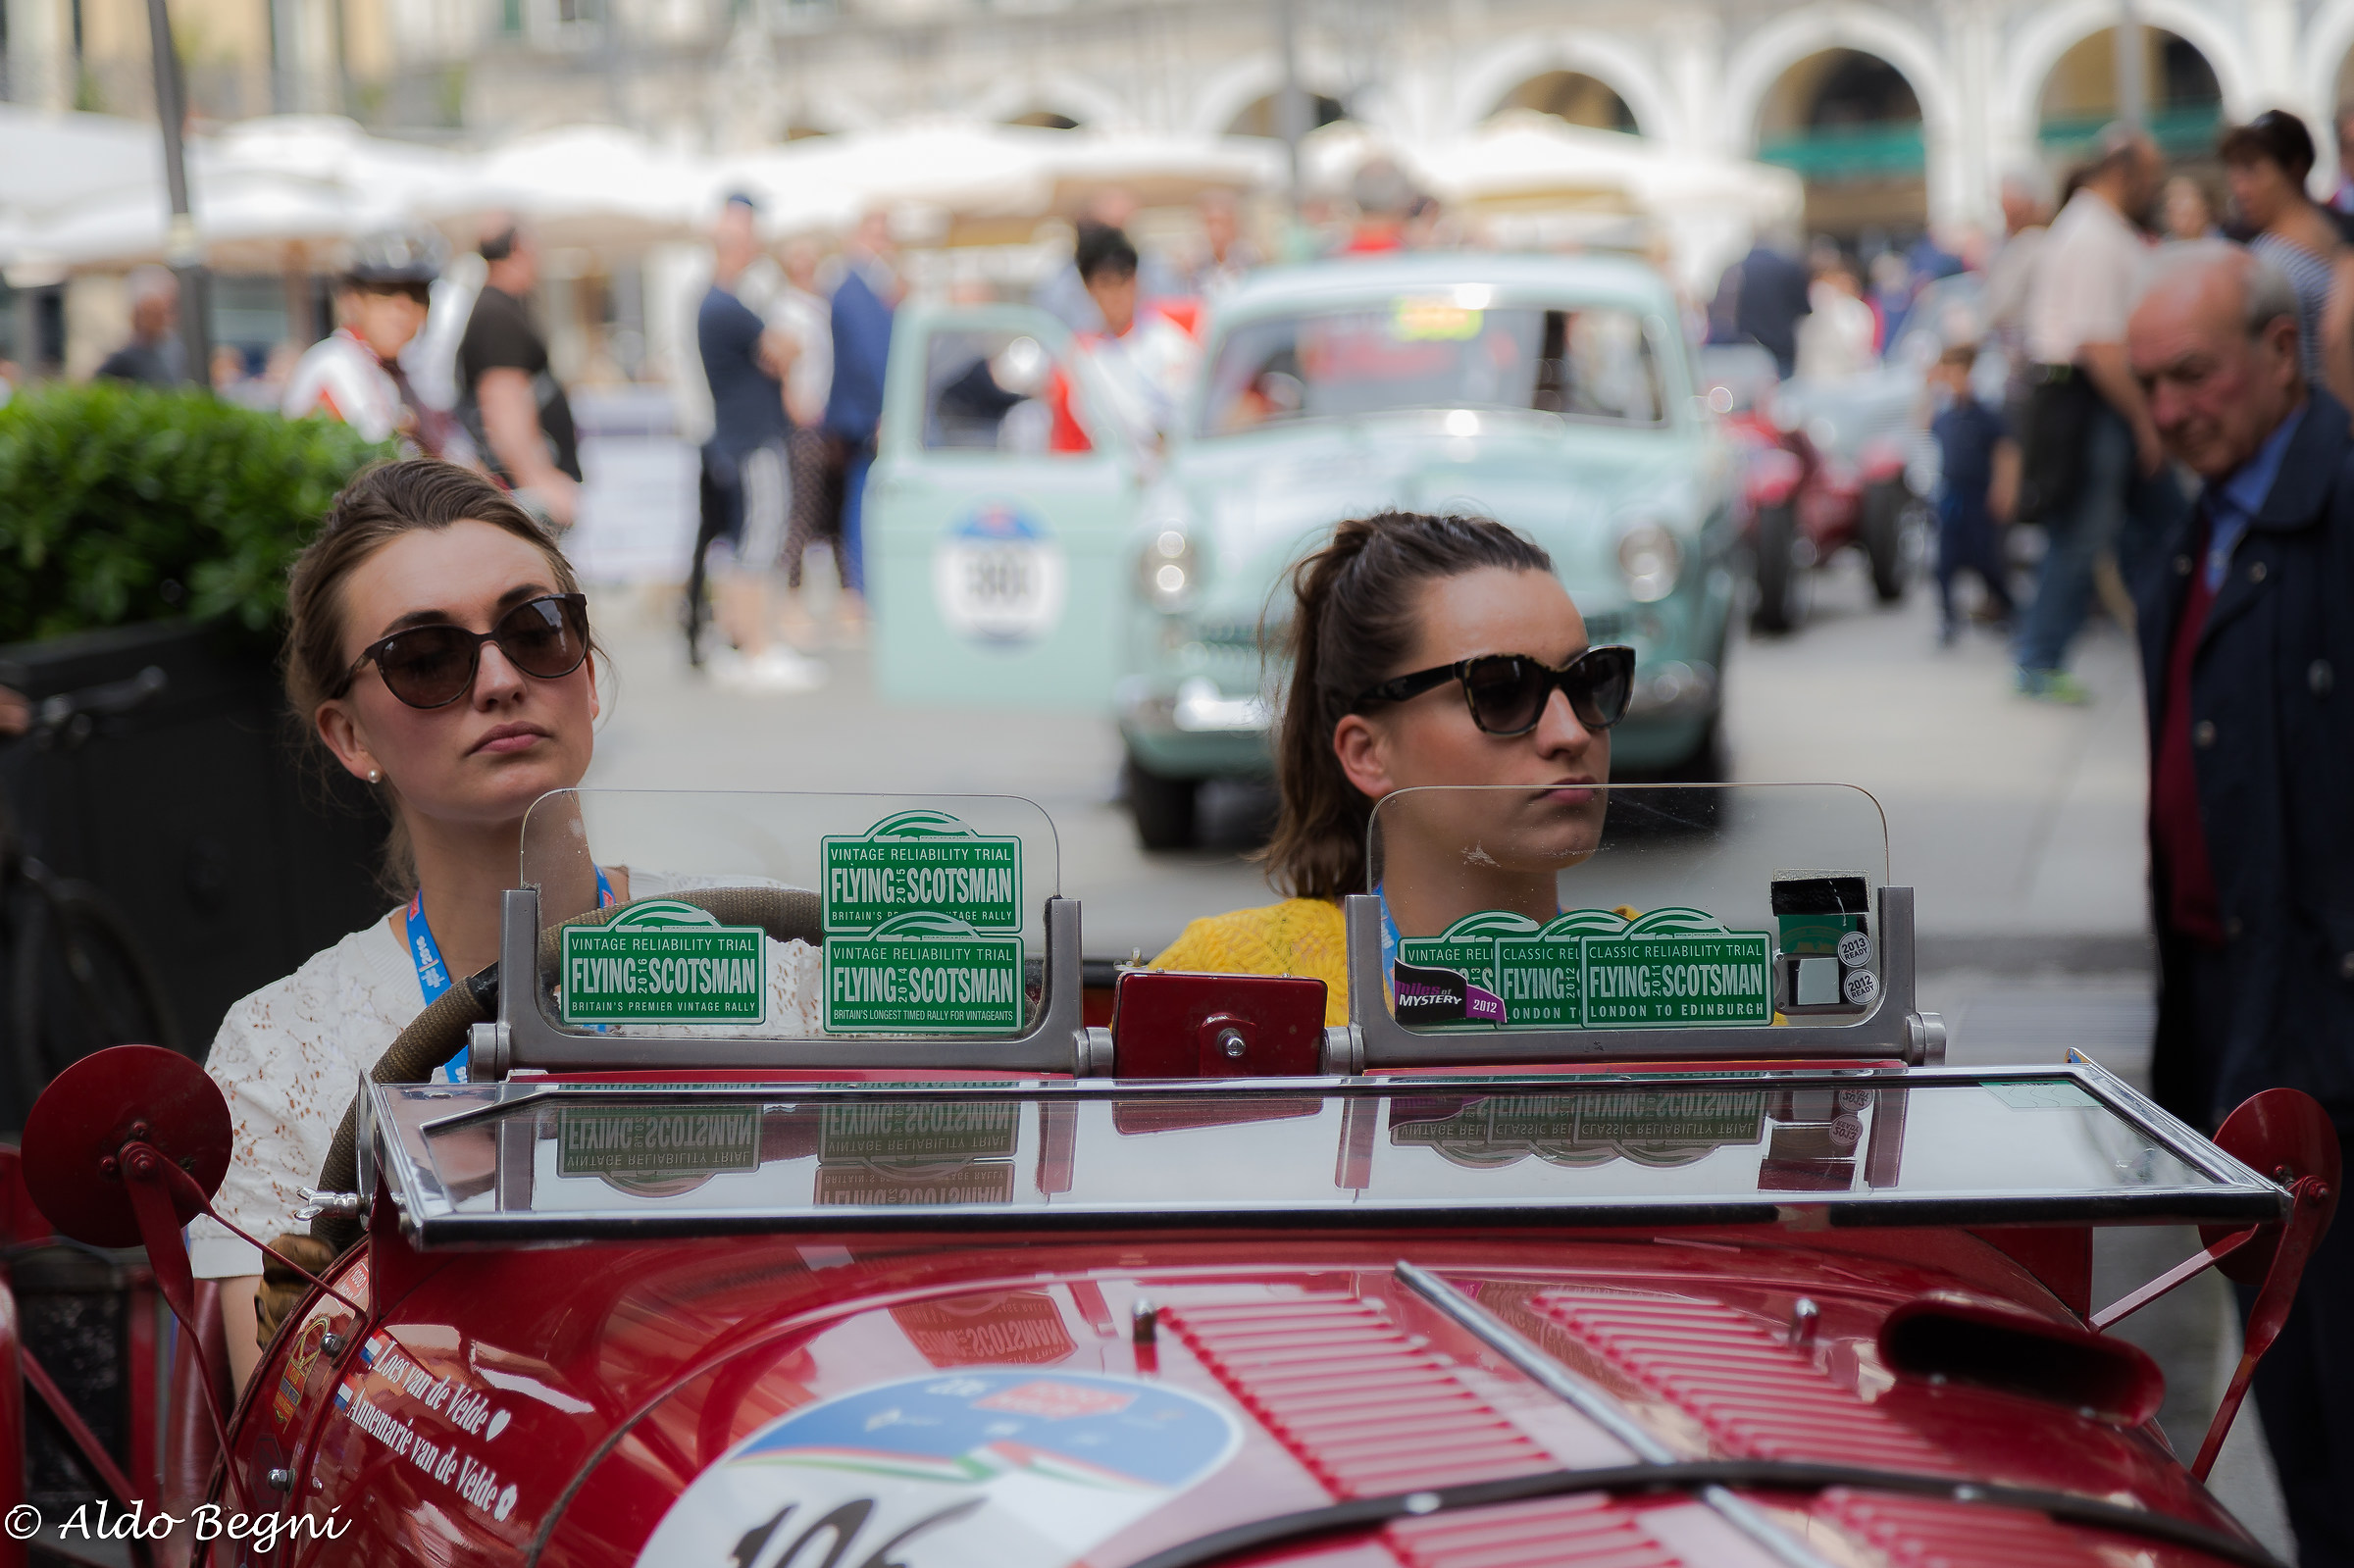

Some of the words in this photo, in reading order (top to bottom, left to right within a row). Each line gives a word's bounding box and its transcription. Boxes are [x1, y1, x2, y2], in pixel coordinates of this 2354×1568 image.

[831, 849, 885, 861] VINTAGE
[891, 849, 969, 861] RELIABILITY
[975, 849, 1011, 861] TRIAL
[832, 868, 895, 903] FLYING
[896, 868, 906, 904] 2015
[907, 868, 1012, 903] SCOTSMAN
[832, 911, 882, 921] BRITAIN'S
[983, 911, 1012, 921] RALLY
[572, 938, 626, 950] VINTAGE
[633, 938, 712, 951] RELIABILITY
[718, 938, 754, 951] TRIAL
[1589, 946, 1639, 959] CLASSIC
[1645, 944, 1720, 958] RELIABILITY
[1726, 944, 1762, 956] TRIAL
[1842, 937, 1867, 953] 2013
[833, 947, 888, 960] VINTAGE
[894, 948, 971, 960] RELIABILITY
[977, 948, 1012, 961] TRIAL
[1407, 949, 1460, 961] VINTAGE
[1503, 948, 1554, 960] CLASSIC
[1845, 946, 1868, 961] READY
[572, 958, 636, 993] FLYING
[638, 958, 647, 994] 2016
[648, 958, 755, 993] SCOTSMAN
[1590, 965, 1651, 997] FLYING
[1652, 965, 1662, 996] 2011
[1662, 964, 1763, 997] SCOTSMAN
[834, 967, 896, 1002] FLYING
[897, 968, 907, 1003] 2014
[908, 967, 1013, 1003] SCOTSMAN
[1504, 967, 1564, 1000] FLYING
[1566, 967, 1575, 998] 2012
[1848, 975, 1872, 992] 2012
[1851, 985, 1874, 998] READY
[572, 1001, 623, 1011] BRITAIN'S
[629, 1001, 673, 1011] PREMIER
[677, 1002, 719, 1012] VINTAGE
[725, 1002, 755, 1012] RALLY
[1399, 993, 1462, 1007] MYSTERY
[1473, 999, 1498, 1013] 2012
[834, 1009, 868, 1019] BRITAIN'S
[869, 1009, 901, 1020] LONGEST
[903, 1010, 925, 1020] TIMED
[927, 1010, 948, 1021] RALLY
[950, 1010, 964, 1020] FOR
[966, 1010, 1013, 1021] VINTAGEANTS
[1508, 1007, 1561, 1020] ONDON
[1591, 1005, 1647, 1018] LONDON
[1656, 1004, 1672, 1016] TO
[1681, 1003, 1763, 1016] EDINBURGH
[373, 1340, 410, 1384] Loes
[402, 1366, 434, 1400] van
[426, 1375, 451, 1410] de
[445, 1383, 490, 1436] Velde
[346, 1388, 414, 1455] Annemarie
[410, 1436, 439, 1474] van
[435, 1446, 458, 1486] de
[456, 1455, 498, 1511] Velde
